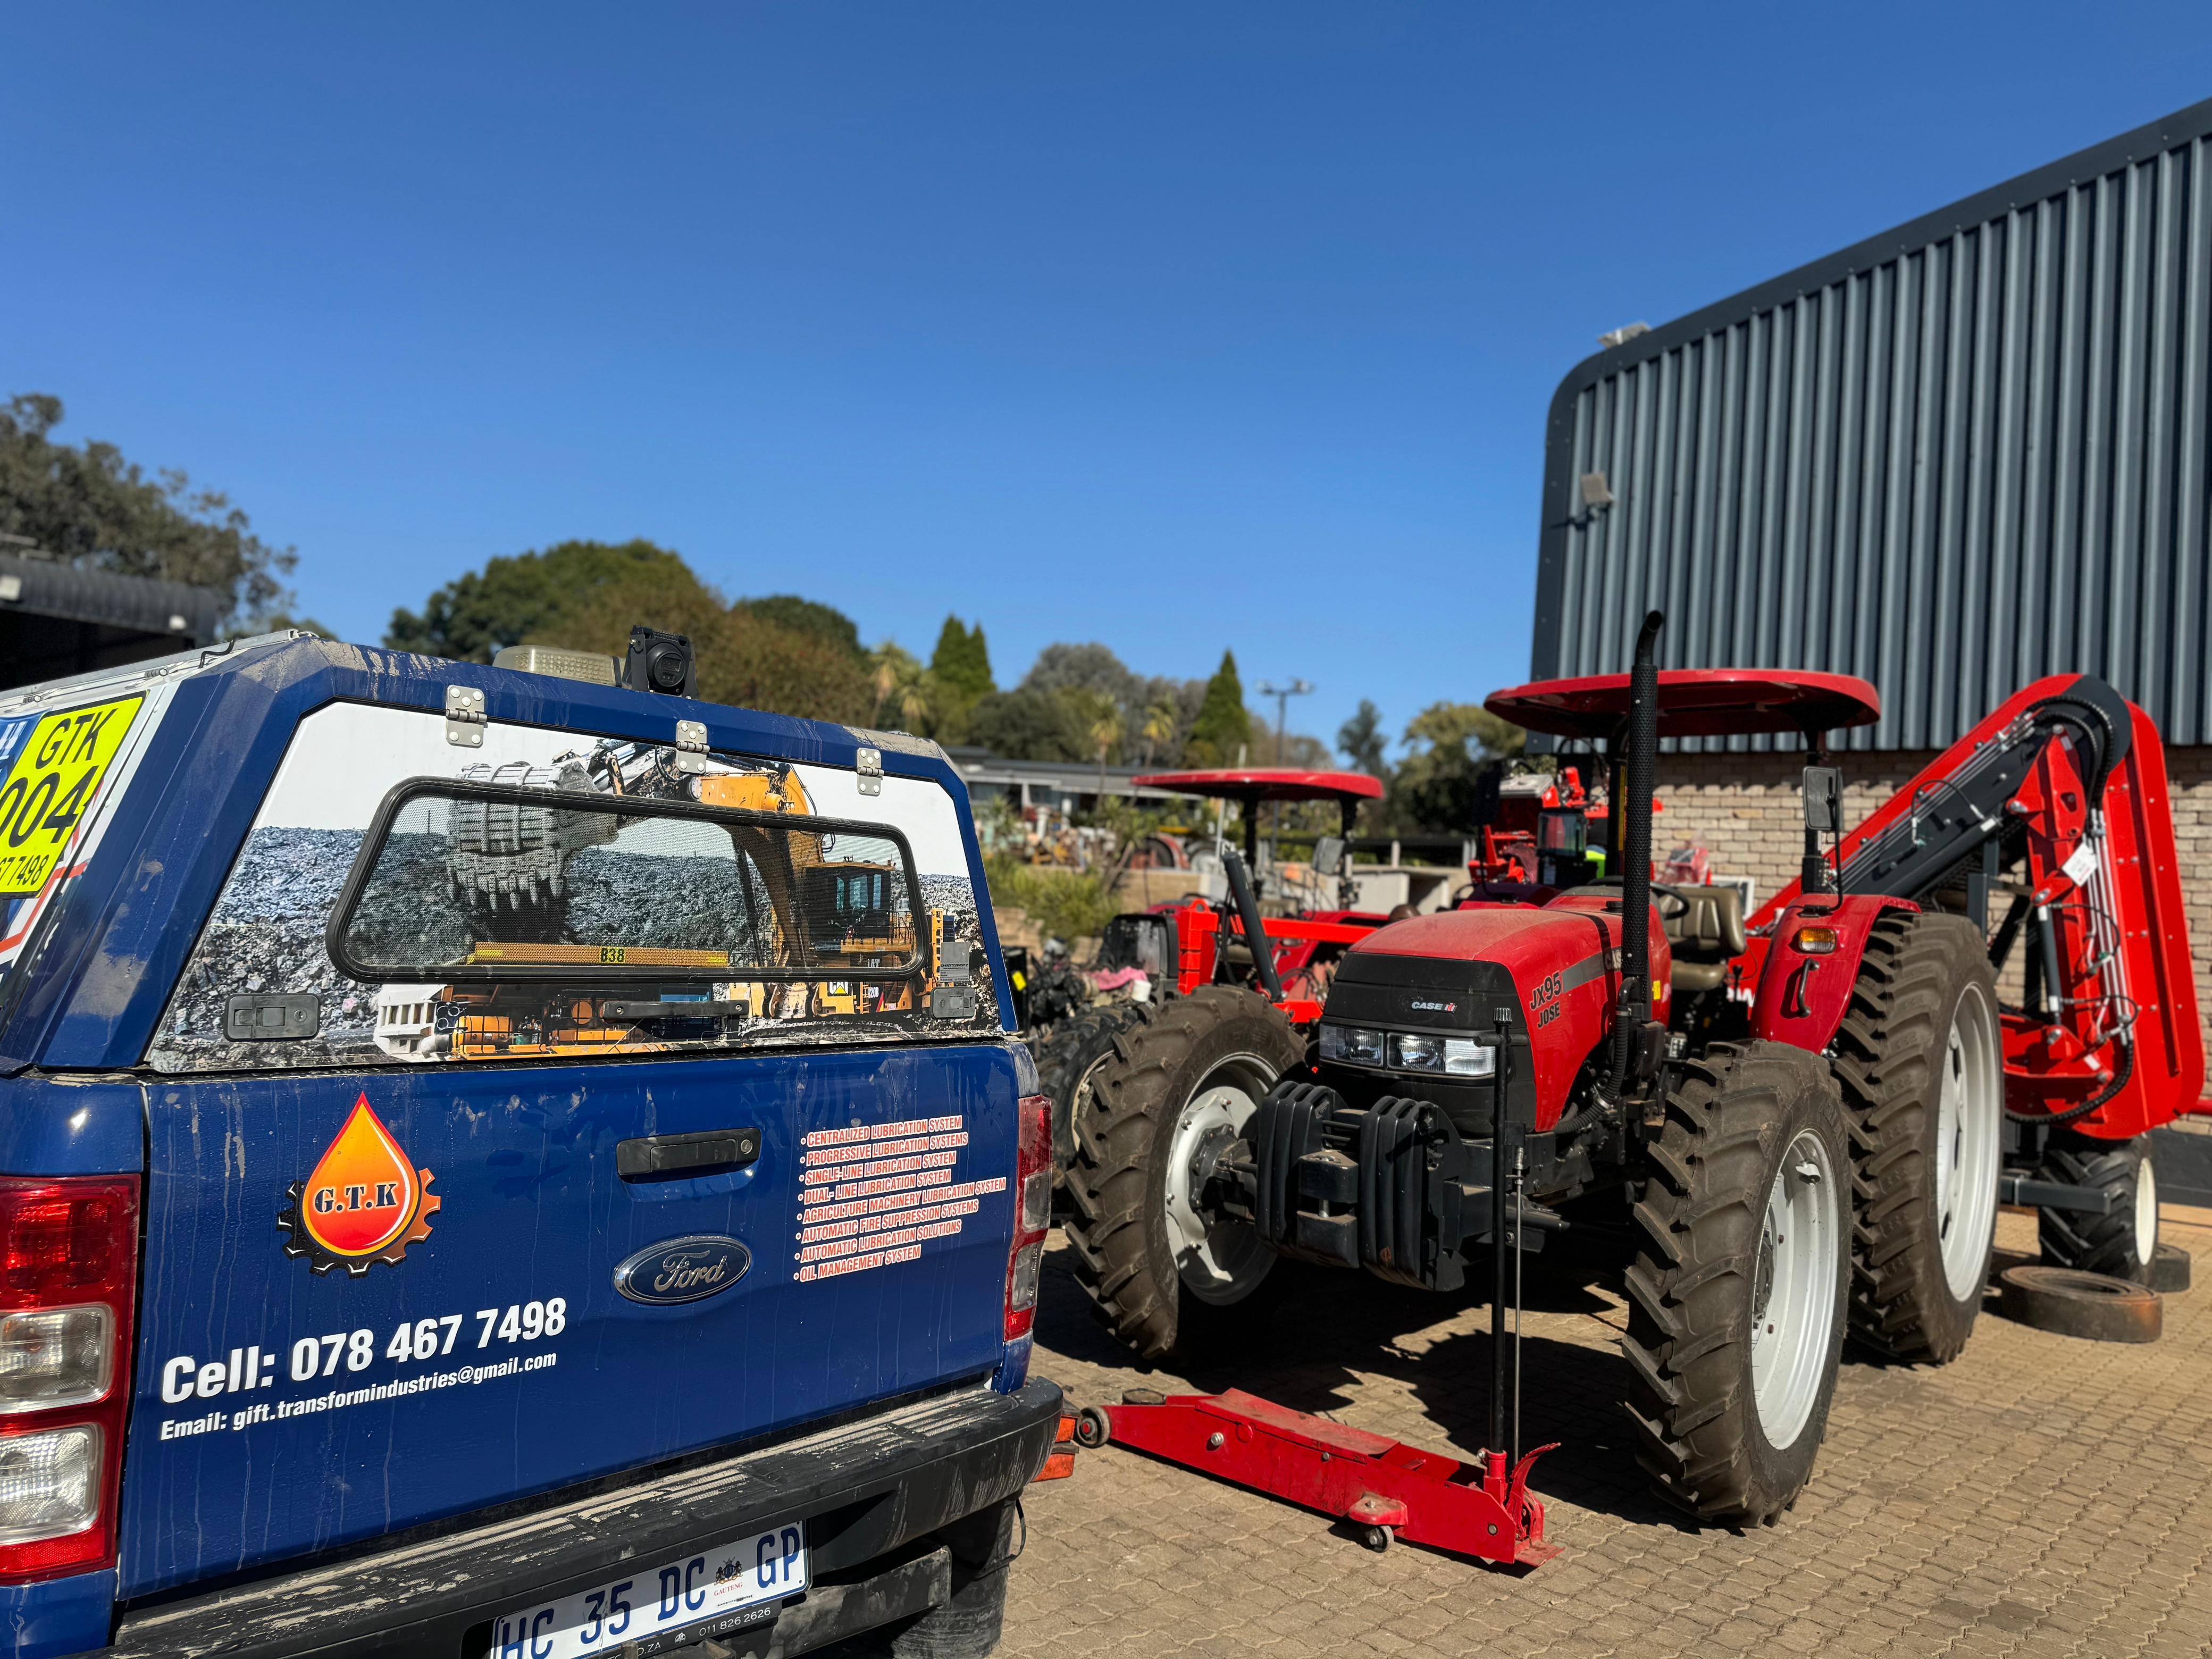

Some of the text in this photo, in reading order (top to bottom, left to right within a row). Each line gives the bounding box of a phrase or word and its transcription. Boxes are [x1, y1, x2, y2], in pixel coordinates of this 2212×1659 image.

[36, 708, 119, 769] GTK
[7, 854, 49, 886] 7498
[600, 948, 625, 962] B38
[1411, 1001, 1443, 1010] CASE
[1530, 971, 1562, 1010] JX95
[1537, 1001, 1561, 1029] JOSE
[806, 1132, 968, 1166] PROGRESSIVE LUBRICATION SYSTEMS
[807, 1115, 962, 1147] CENTRALIZED LUBRICATION SYSTEM
[805, 1151, 957, 1185] SINGLE-LINE LUBRICATION SYSTEM
[315, 1184, 396, 1212] G.T.K
[802, 1177, 1006, 1224] AGRICULTURE MACHINERY LUBRICATION SYSTEM
[805, 1169, 951, 1205] DUAL- LINE LUBRICATION SYSTEM
[801, 1199, 979, 1244] AUTOMATIC FIRE SUPPRESSION SYSTEMS
[800, 1219, 962, 1263] AUTOMATIC LUBRICATION SOLUTIONS
[654, 1250, 727, 1292] Ford
[800, 1244, 921, 1282] OIL MANAGEMENT SYSTEM
[162, 1297, 566, 1403] Cell: 078 467 7498
[161, 1353, 557, 1440] Email: gift.transformindustries@gmail.com
[501, 1527, 800, 1659] HC 35 DC GP
[714, 1582, 743, 1596] GAUTENG
[699, 1624, 716, 1637] 011
[720, 1617, 741, 1630] 826
[743, 1607, 771, 1622] 2626
